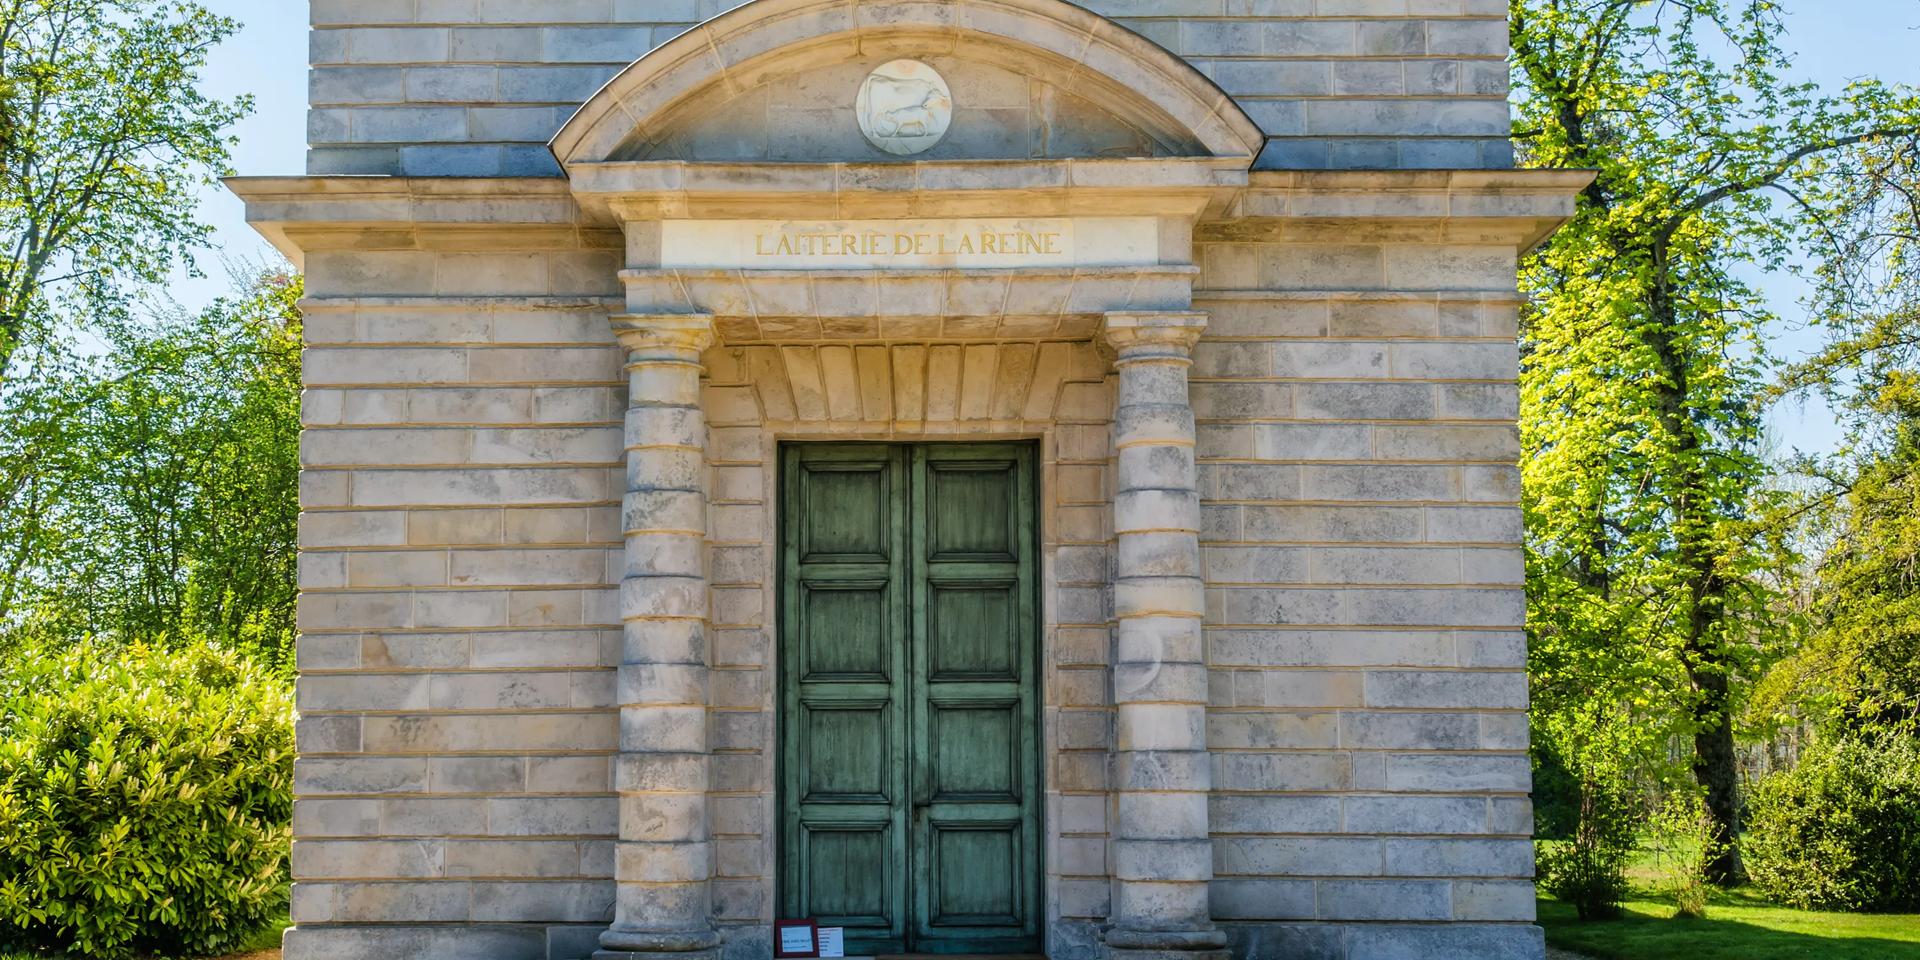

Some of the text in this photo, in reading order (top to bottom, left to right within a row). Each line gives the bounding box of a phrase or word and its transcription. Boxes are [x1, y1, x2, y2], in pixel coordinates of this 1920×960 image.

[755, 232, 1062, 256] LAITERIE DE LA REINE
